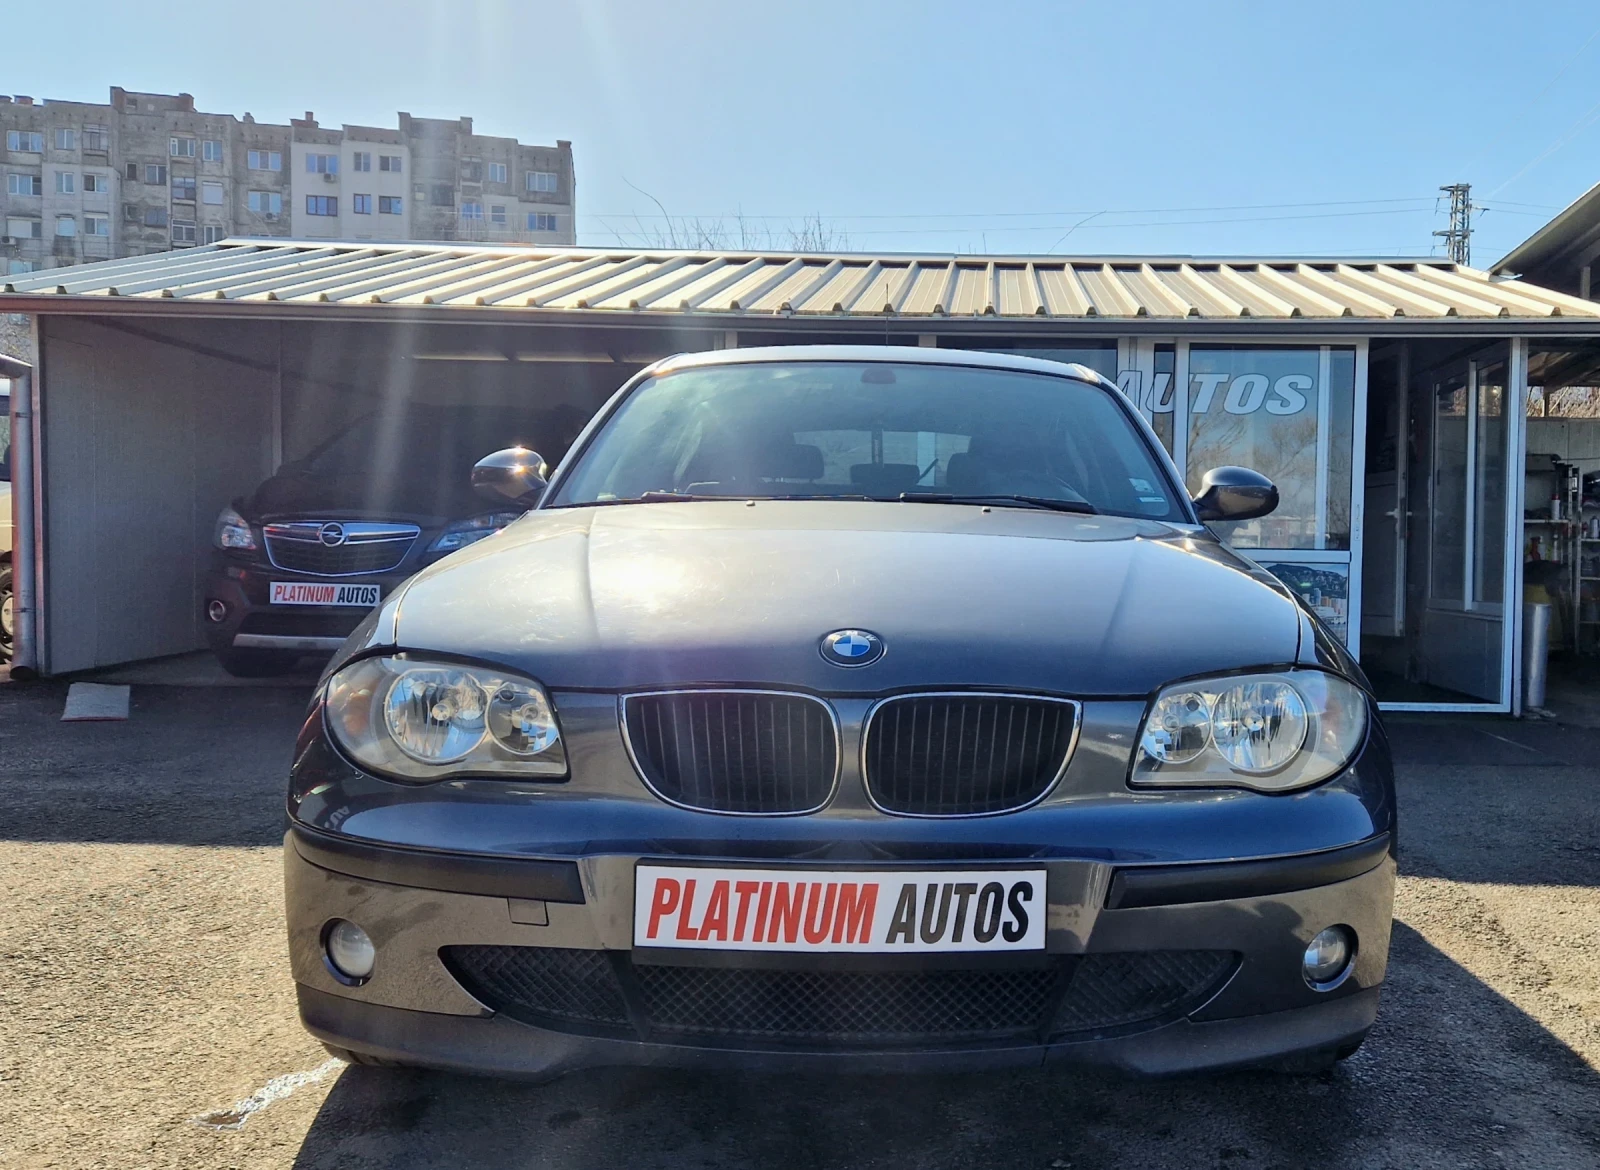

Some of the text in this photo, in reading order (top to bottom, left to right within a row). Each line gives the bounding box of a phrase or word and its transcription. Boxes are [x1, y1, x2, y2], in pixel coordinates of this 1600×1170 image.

[275, 585, 377, 604] PLATINUM AUTOS
[646, 877, 1034, 944] PLATINUM AUTOS
